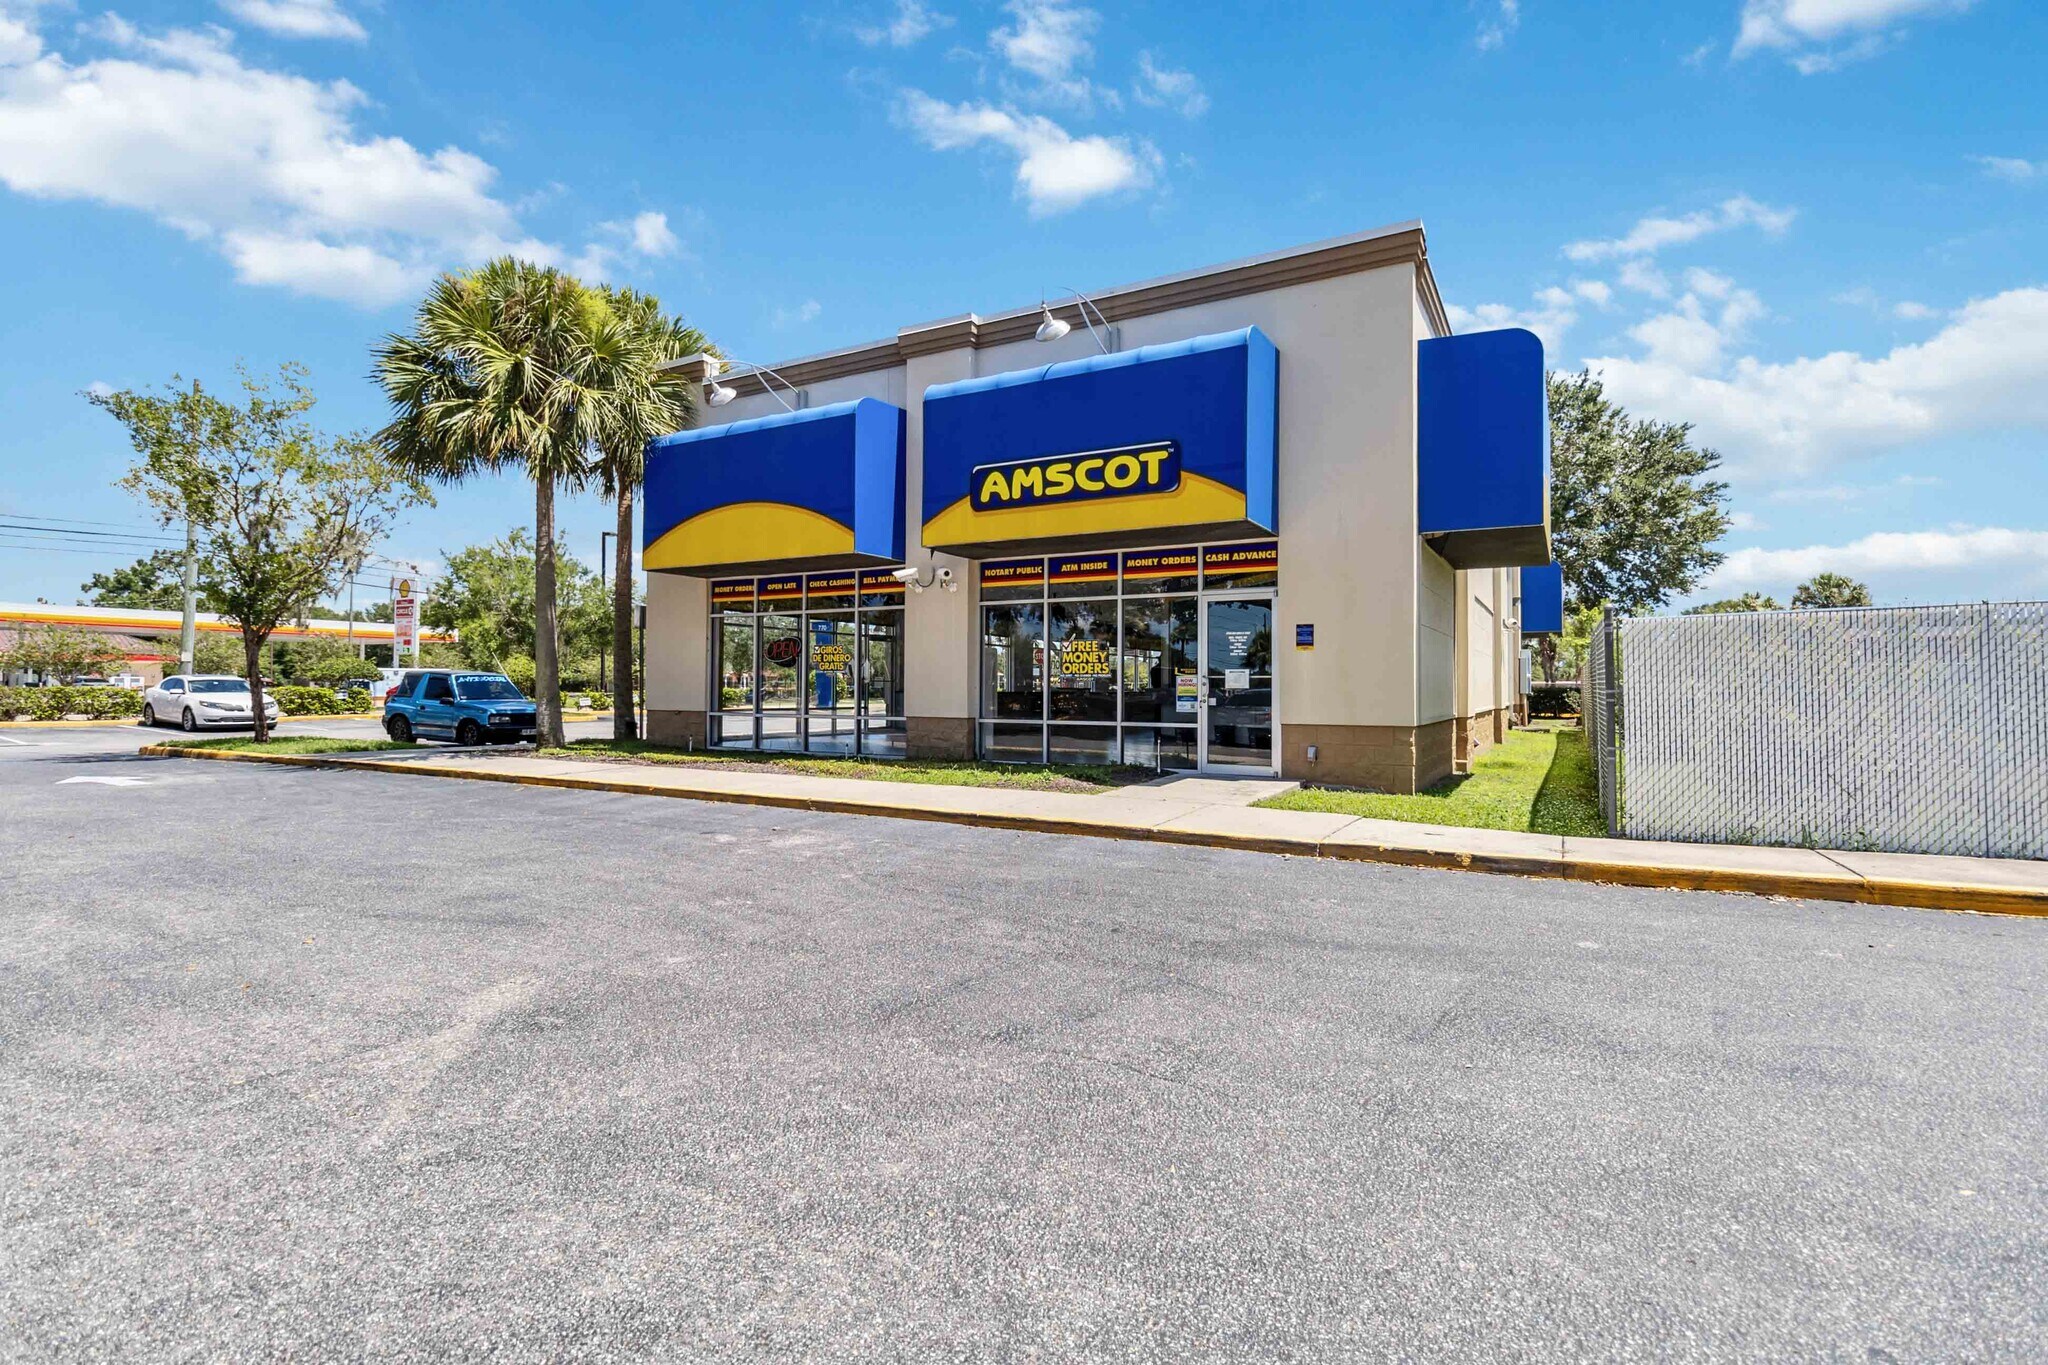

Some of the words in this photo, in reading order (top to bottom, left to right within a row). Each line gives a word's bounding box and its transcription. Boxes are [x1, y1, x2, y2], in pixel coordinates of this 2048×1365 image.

[980, 450, 1169, 503] AMSCOT
[1126, 557, 1159, 567] MONEY
[1161, 555, 1197, 565] ORDERS
[1205, 552, 1230, 562] CASH
[1232, 550, 1277, 561] ADVANCE
[984, 568, 1015, 577] NOTARY
[1016, 566, 1043, 575] PUBLIC
[1061, 563, 1079, 572] ATM
[1081, 561, 1108, 571] INSIDE
[809, 580, 828, 588] CHECK
[829, 577, 856, 586] CASHING
[863, 576, 876, 584] BILL
[766, 639, 799, 658] OPEN
[820, 646, 843, 654] GIROS
[1072, 641, 1098, 652] FREE
[812, 654, 822, 662] DE
[823, 654, 851, 662] DINERO
[1062, 652, 1107, 663] MONEY
[819, 662, 844, 670] GRATIS
[1062, 663, 1110, 674] ORDERS
